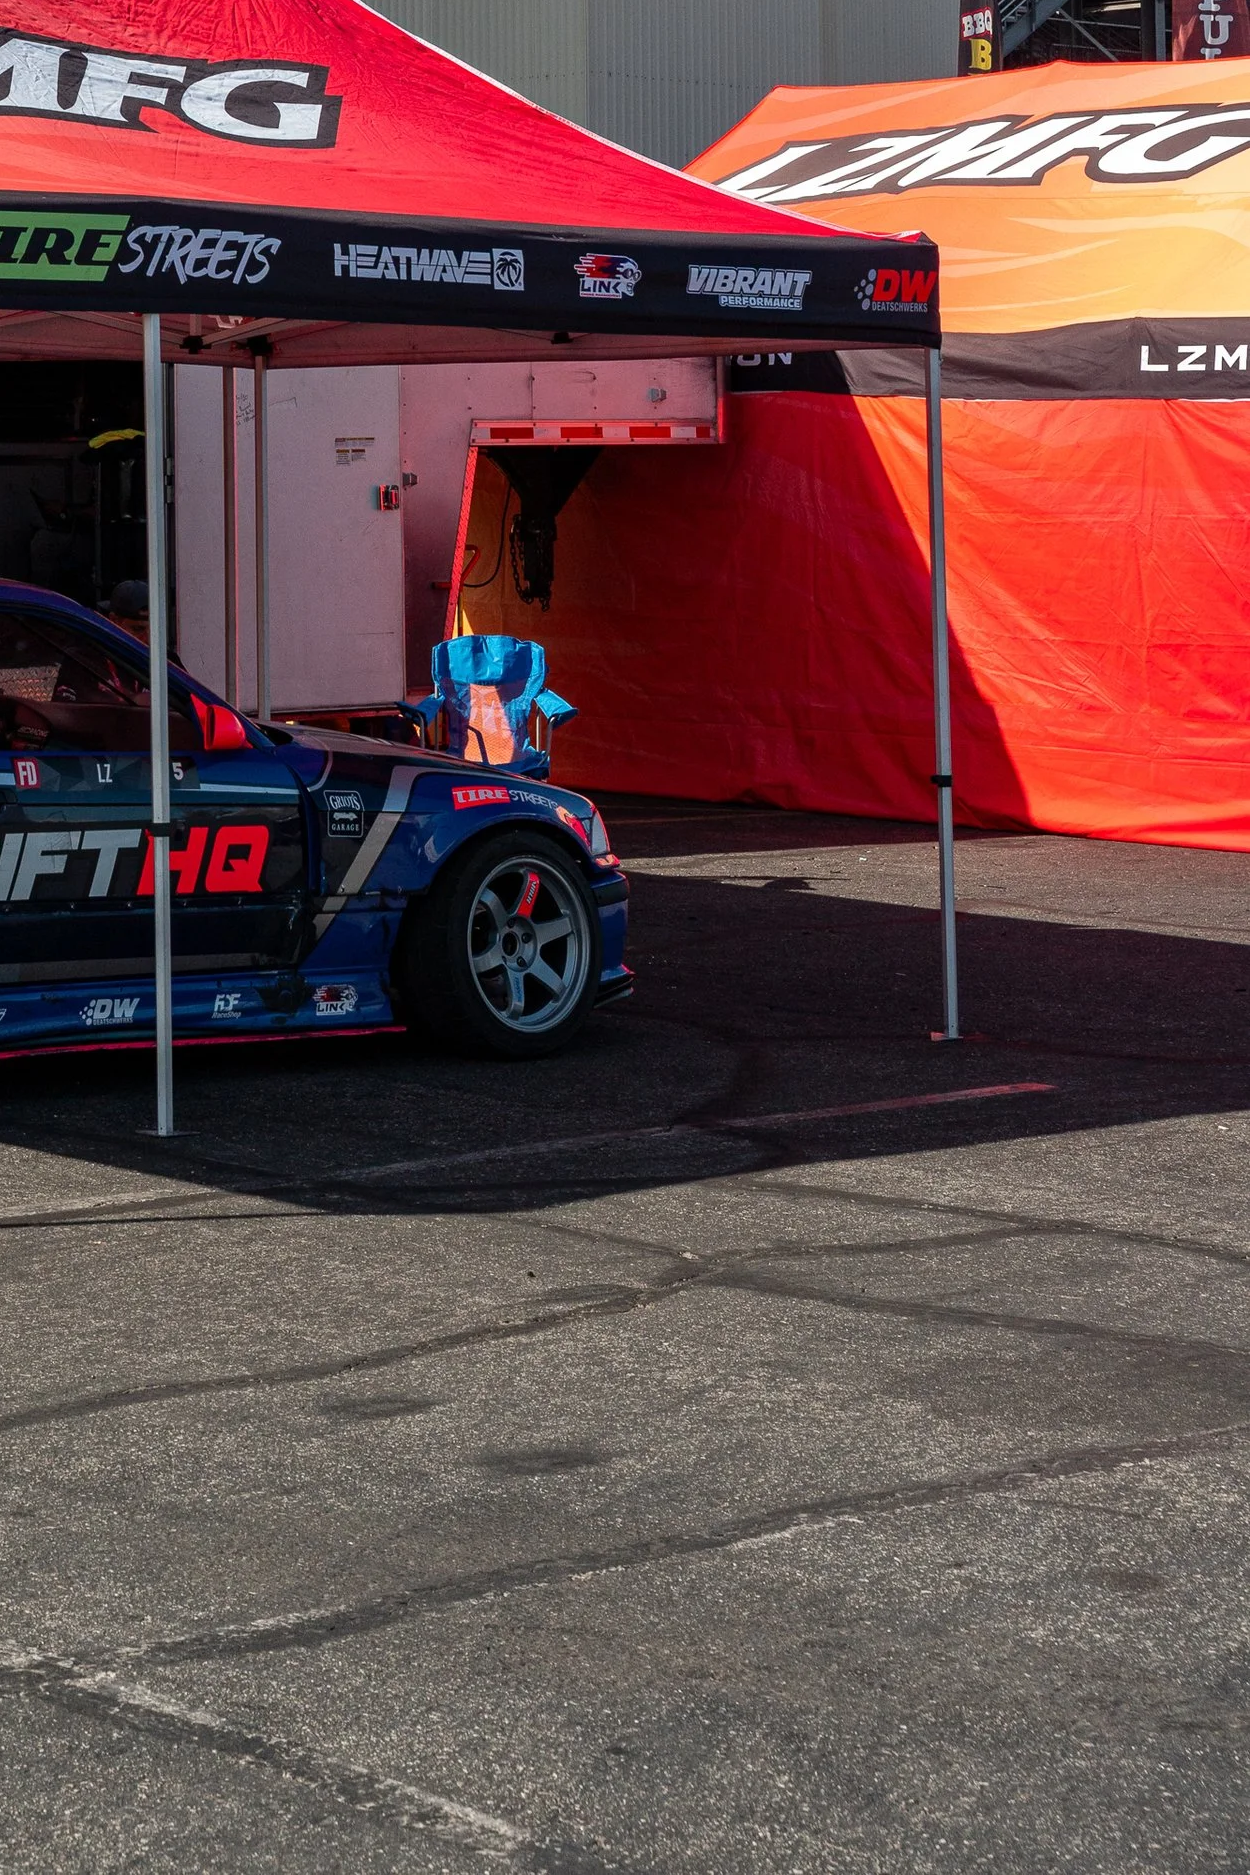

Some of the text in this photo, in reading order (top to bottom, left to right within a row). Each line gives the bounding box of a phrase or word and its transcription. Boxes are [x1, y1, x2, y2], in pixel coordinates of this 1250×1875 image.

[961, 9, 993, 37] BBQ
[118, 225, 282, 285] STREETS
[333, 243, 492, 285] HEATWAVE
[581, 279, 623, 294] LINK
[687, 265, 812, 297] VIBRANT
[872, 268, 937, 302] DW
[719, 294, 802, 310] PERFORMANCE
[871, 301, 928, 313] DEATSCHWERKS
[17, 761, 184, 787] FD LZ 5
[328, 794, 362, 811] GRIOT'S
[453, 787, 509, 805] TIRE
[331, 823, 361, 832] GARAGE
[137, 825, 269, 897] HQ
[92, 998, 141, 1019] DW
